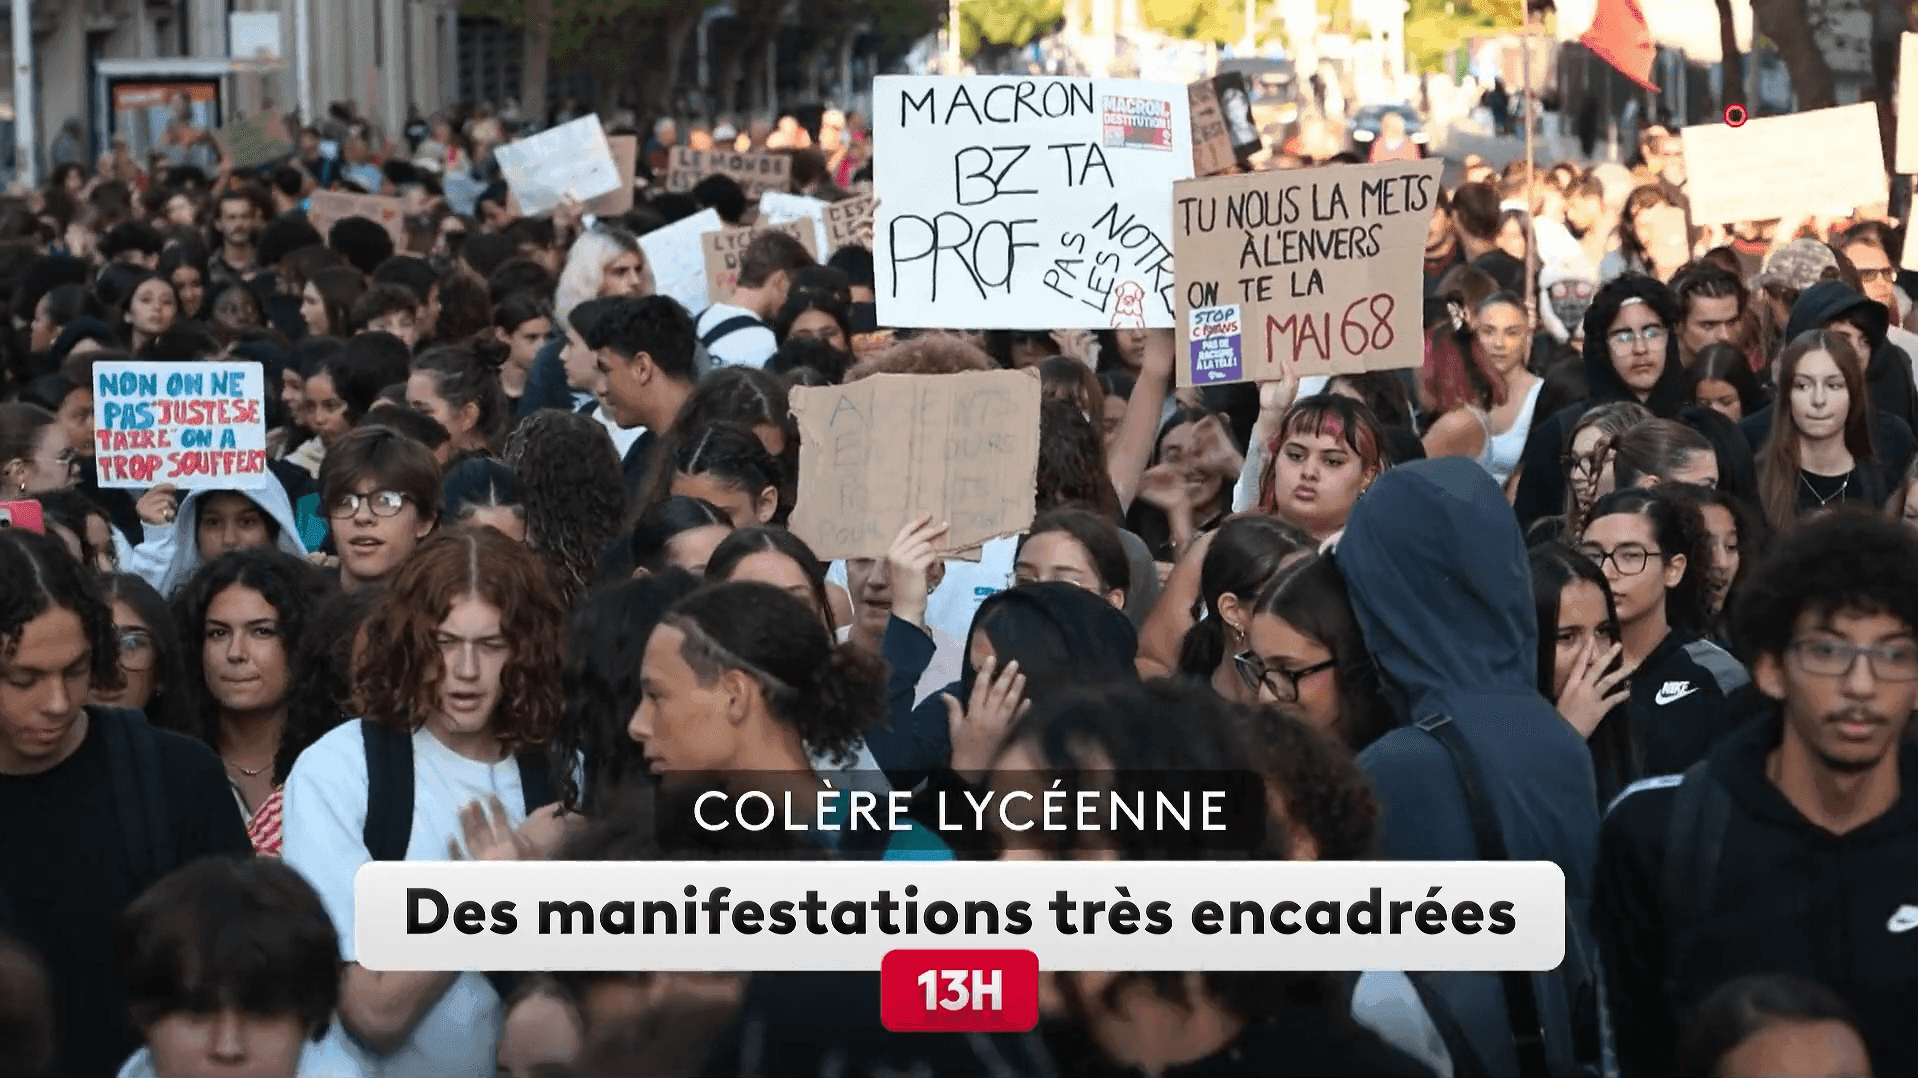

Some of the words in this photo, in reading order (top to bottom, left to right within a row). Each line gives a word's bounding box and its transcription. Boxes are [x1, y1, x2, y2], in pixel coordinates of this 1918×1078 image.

[901, 81, 1094, 128] MACRON
[955, 145, 1038, 206] BZ
[1048, 142, 1114, 188] TA
[1178, 197, 1216, 236] TU
[1227, 186, 1301, 230] NOUS
[1312, 183, 1349, 221] LA
[1361, 174, 1433, 218] METS
[890, 211, 1039, 303] PROF
[1043, 231, 1085, 298] PAS
[1081, 251, 1120, 313] LES
[1187, 281, 1219, 309] ON
[1238, 275, 1273, 302] TE
[1291, 268, 1324, 298] LA
[1194, 308, 1234, 325] STOP
[1266, 312, 1331, 363] MAI
[1341, 293, 1395, 355] 68
[99, 370, 158, 397] NON
[166, 372, 203, 397] ON
[211, 370, 245, 397] NE
[104, 401, 155, 430] PAS
[180, 429, 213, 449] ON
[219, 428, 237, 450] A
[98, 454, 164, 481] TROP
[167, 450, 267, 478] SOUFFERT
